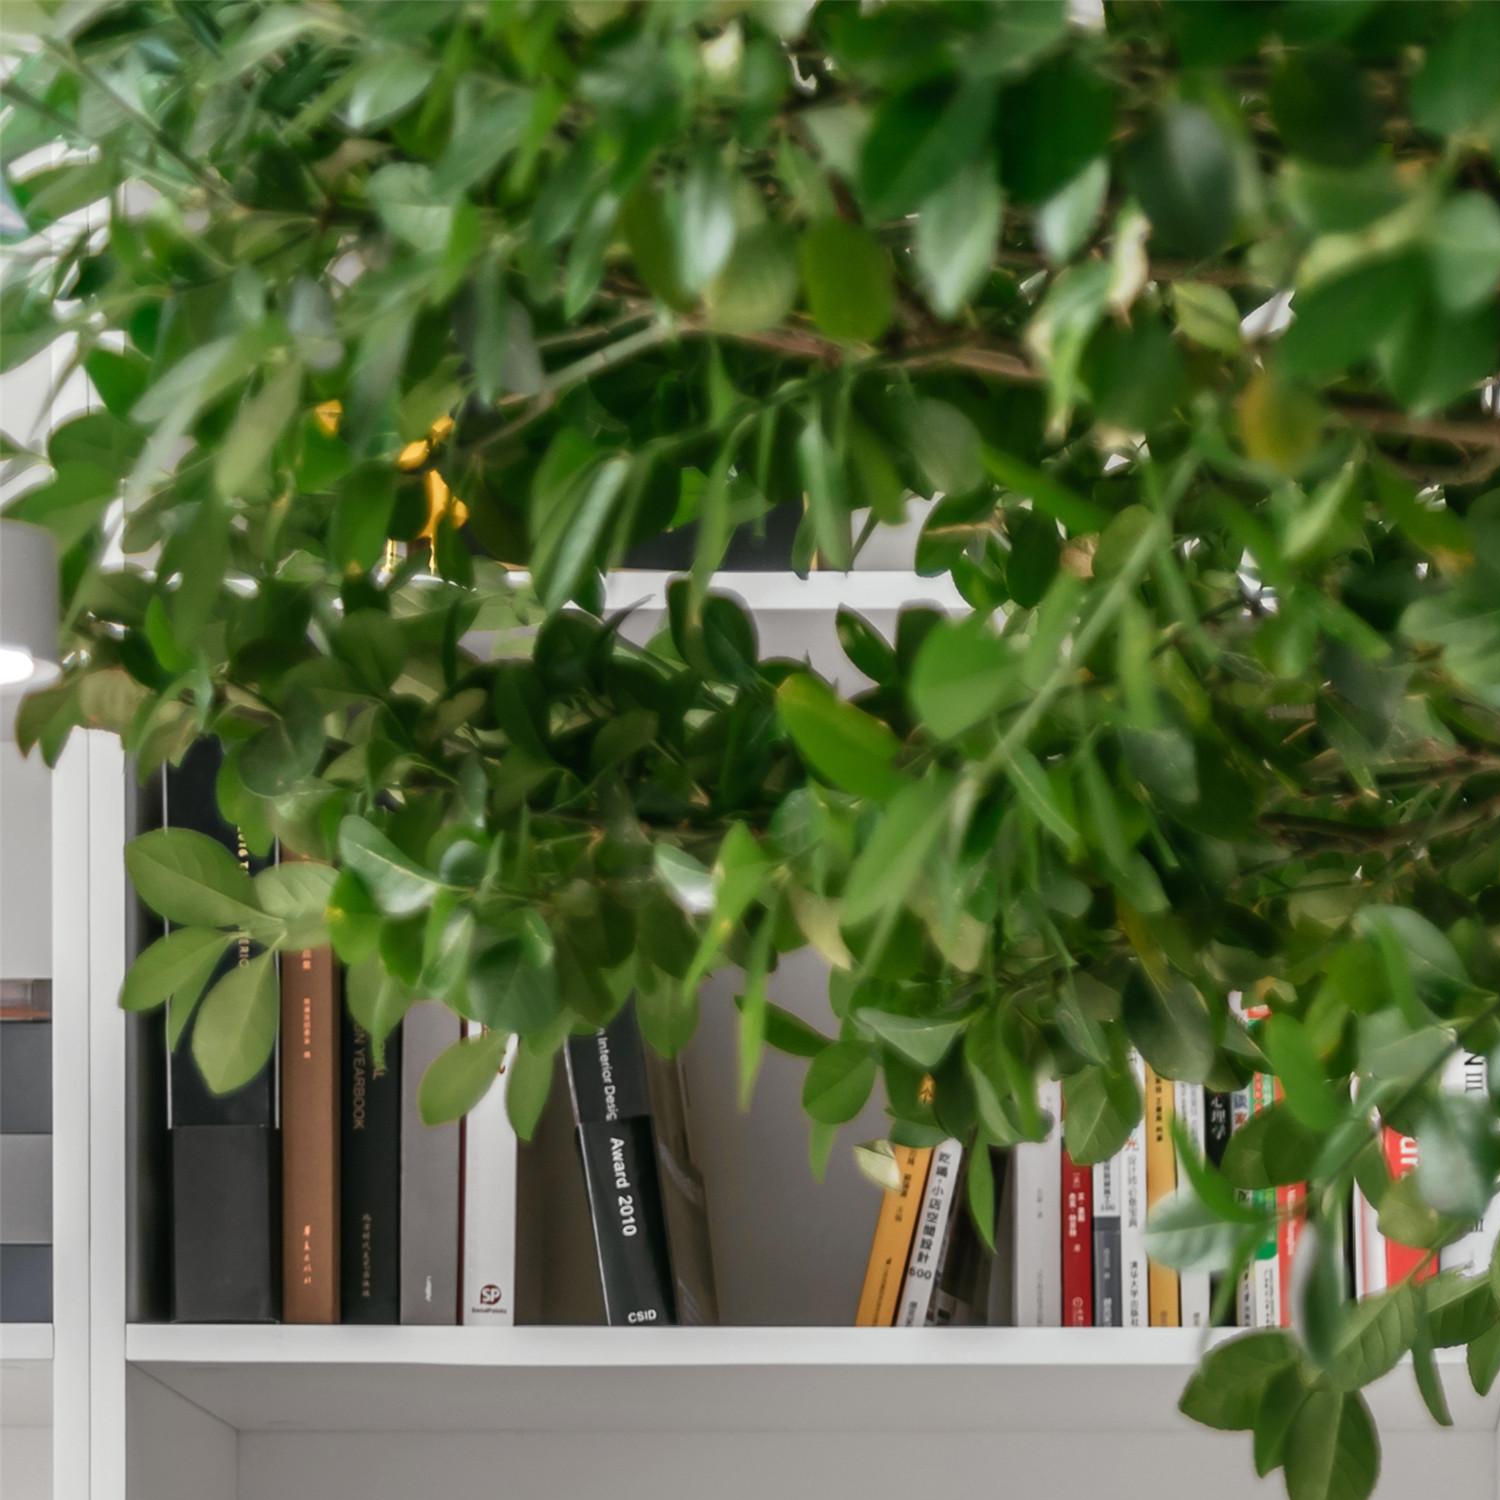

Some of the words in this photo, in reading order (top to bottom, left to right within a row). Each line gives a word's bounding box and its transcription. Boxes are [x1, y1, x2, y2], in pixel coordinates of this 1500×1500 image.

[597, 1036, 614, 1084] Interior
[353, 1050, 366, 1130] YEARBOOK
[609, 1137, 631, 1190] Award
[617, 1194, 637, 1237] 2010
[627, 1308, 658, 1324] CSID
